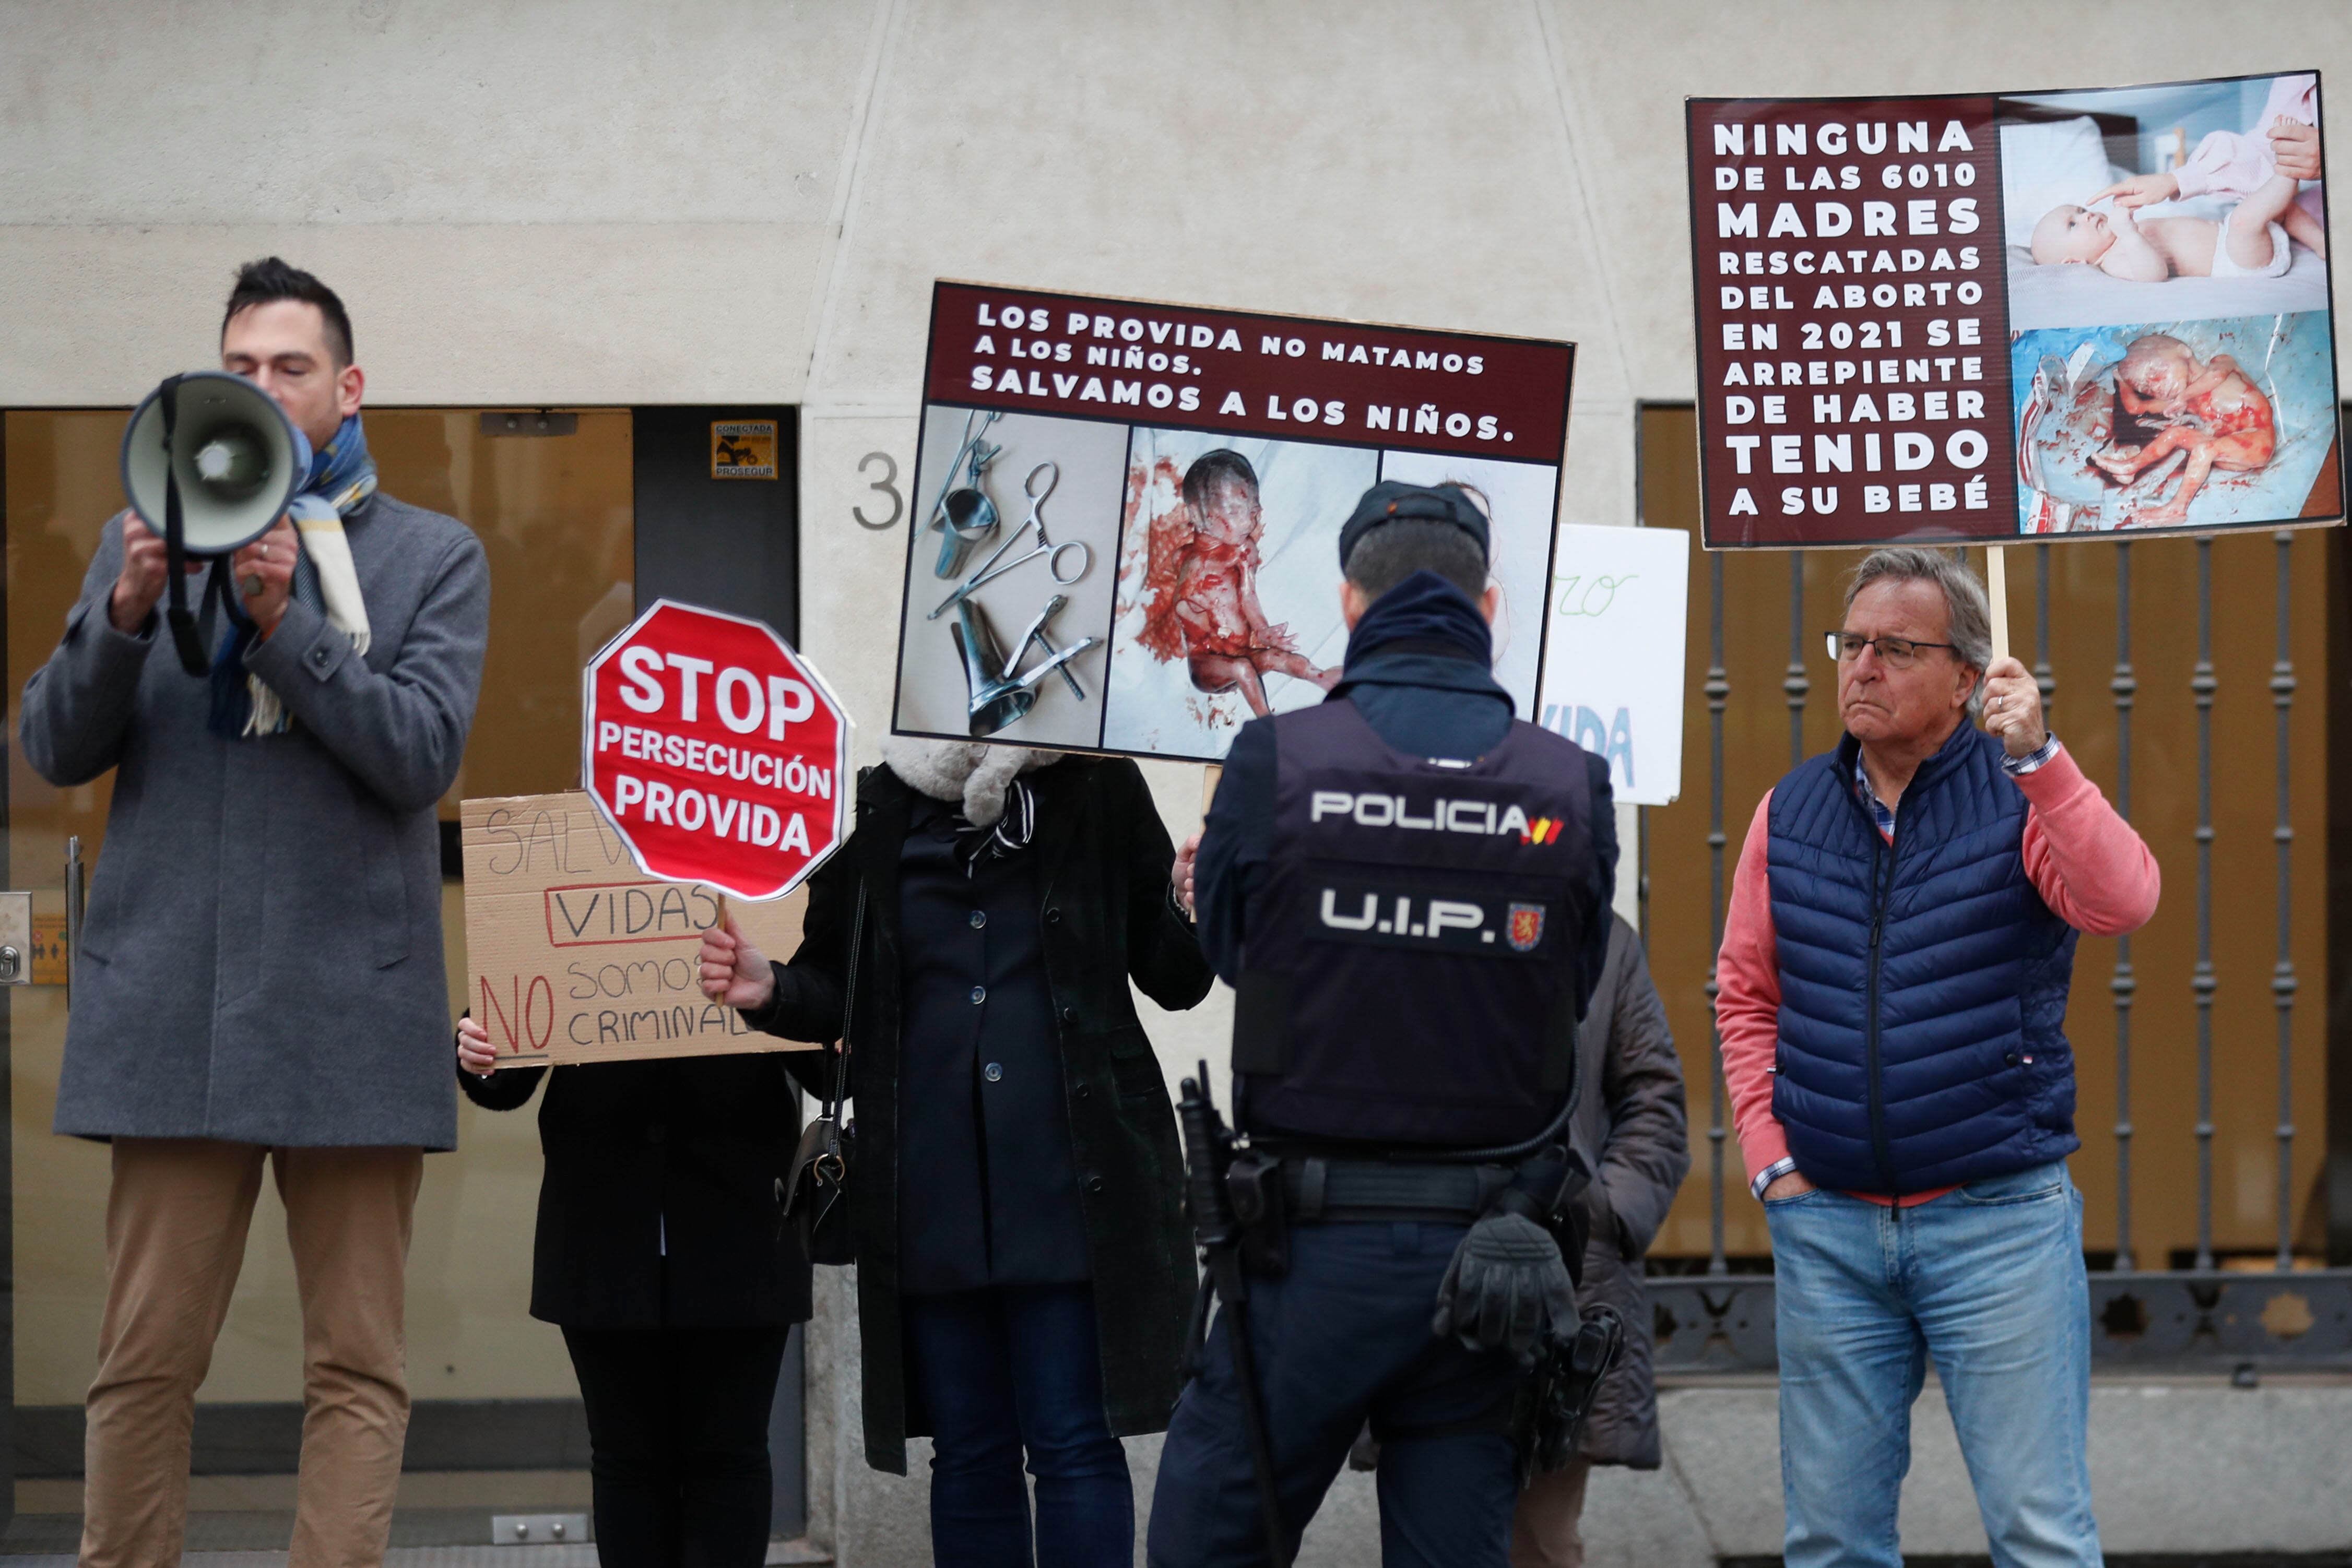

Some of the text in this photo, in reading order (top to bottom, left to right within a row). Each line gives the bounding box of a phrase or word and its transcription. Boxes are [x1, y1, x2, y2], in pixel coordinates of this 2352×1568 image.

[1713, 120, 1974, 156] NINGUNA
[1715, 162, 1976, 191] DE LAS 6010
[1717, 197, 1980, 239] MADRES
[1719, 246, 1980, 275] RESCATADAS
[1720, 280, 1983, 310] DEL ABORTO
[974, 335, 1202, 376] A LOS NIÑOS.
[978, 303, 1484, 375] LOS PROVIDA NO MATAMOS
[1722, 317, 1981, 351] EN 2021 SE
[1722, 356, 1983, 386] ARREPIENTE
[971, 365, 1514, 442] SALVAMOS A LOS NIÑOS.
[1725, 389, 1985, 425] DE HABER
[1725, 429, 1989, 474] TENIDO
[853, 452, 903, 531] 3
[1728, 473, 1989, 516] A SU BEBÉ
[619, 645, 815, 741] STOP
[599, 721, 832, 800] PERSECUCIÓN
[1540, 705, 1635, 788] DA
[615, 774, 812, 857] PROVIDA
[1311, 791, 1531, 837] POLICIA
[487, 809, 633, 874] SALV
[555, 885, 718, 937] VIDAS
[1321, 889, 1495, 943] U.I.P.
[481, 975, 554, 1054] NO
